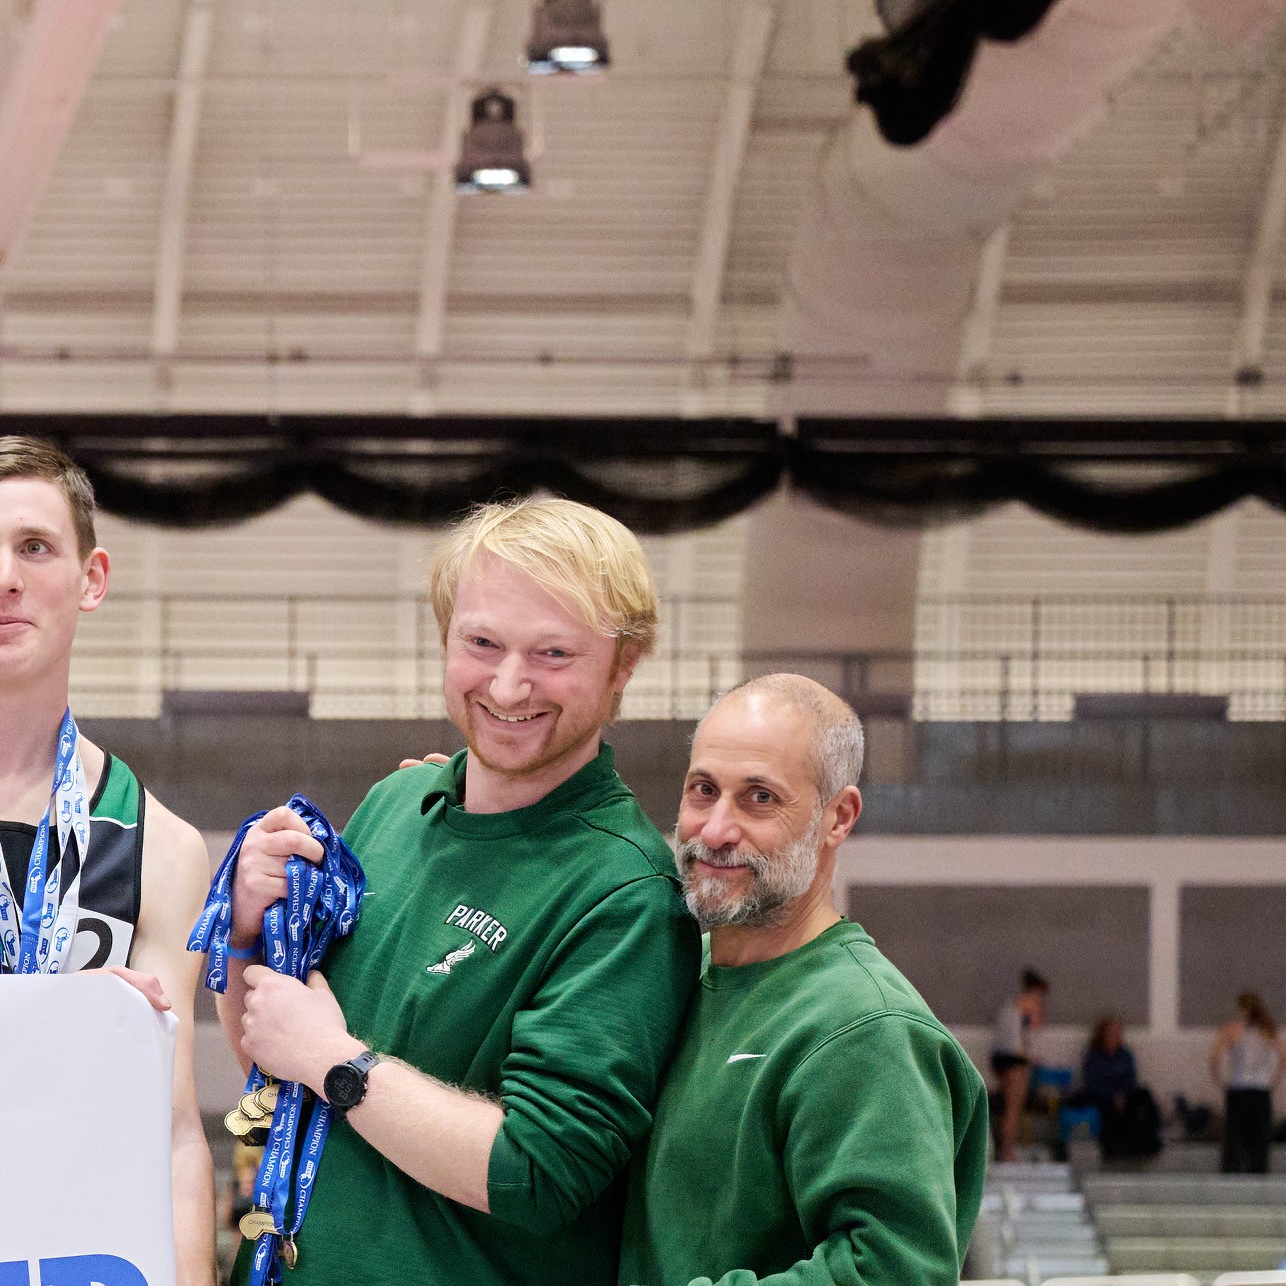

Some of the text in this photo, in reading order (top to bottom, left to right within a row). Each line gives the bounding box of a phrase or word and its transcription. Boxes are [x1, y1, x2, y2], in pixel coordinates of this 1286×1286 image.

[291, 865, 300, 912] CHAMPION
[445, 903, 508, 954] PARKER
[285, 1103, 296, 1149] CHAMPION
[309, 1109, 328, 1156] CHAMPION
[262, 1141, 281, 1187] CHAMPION
